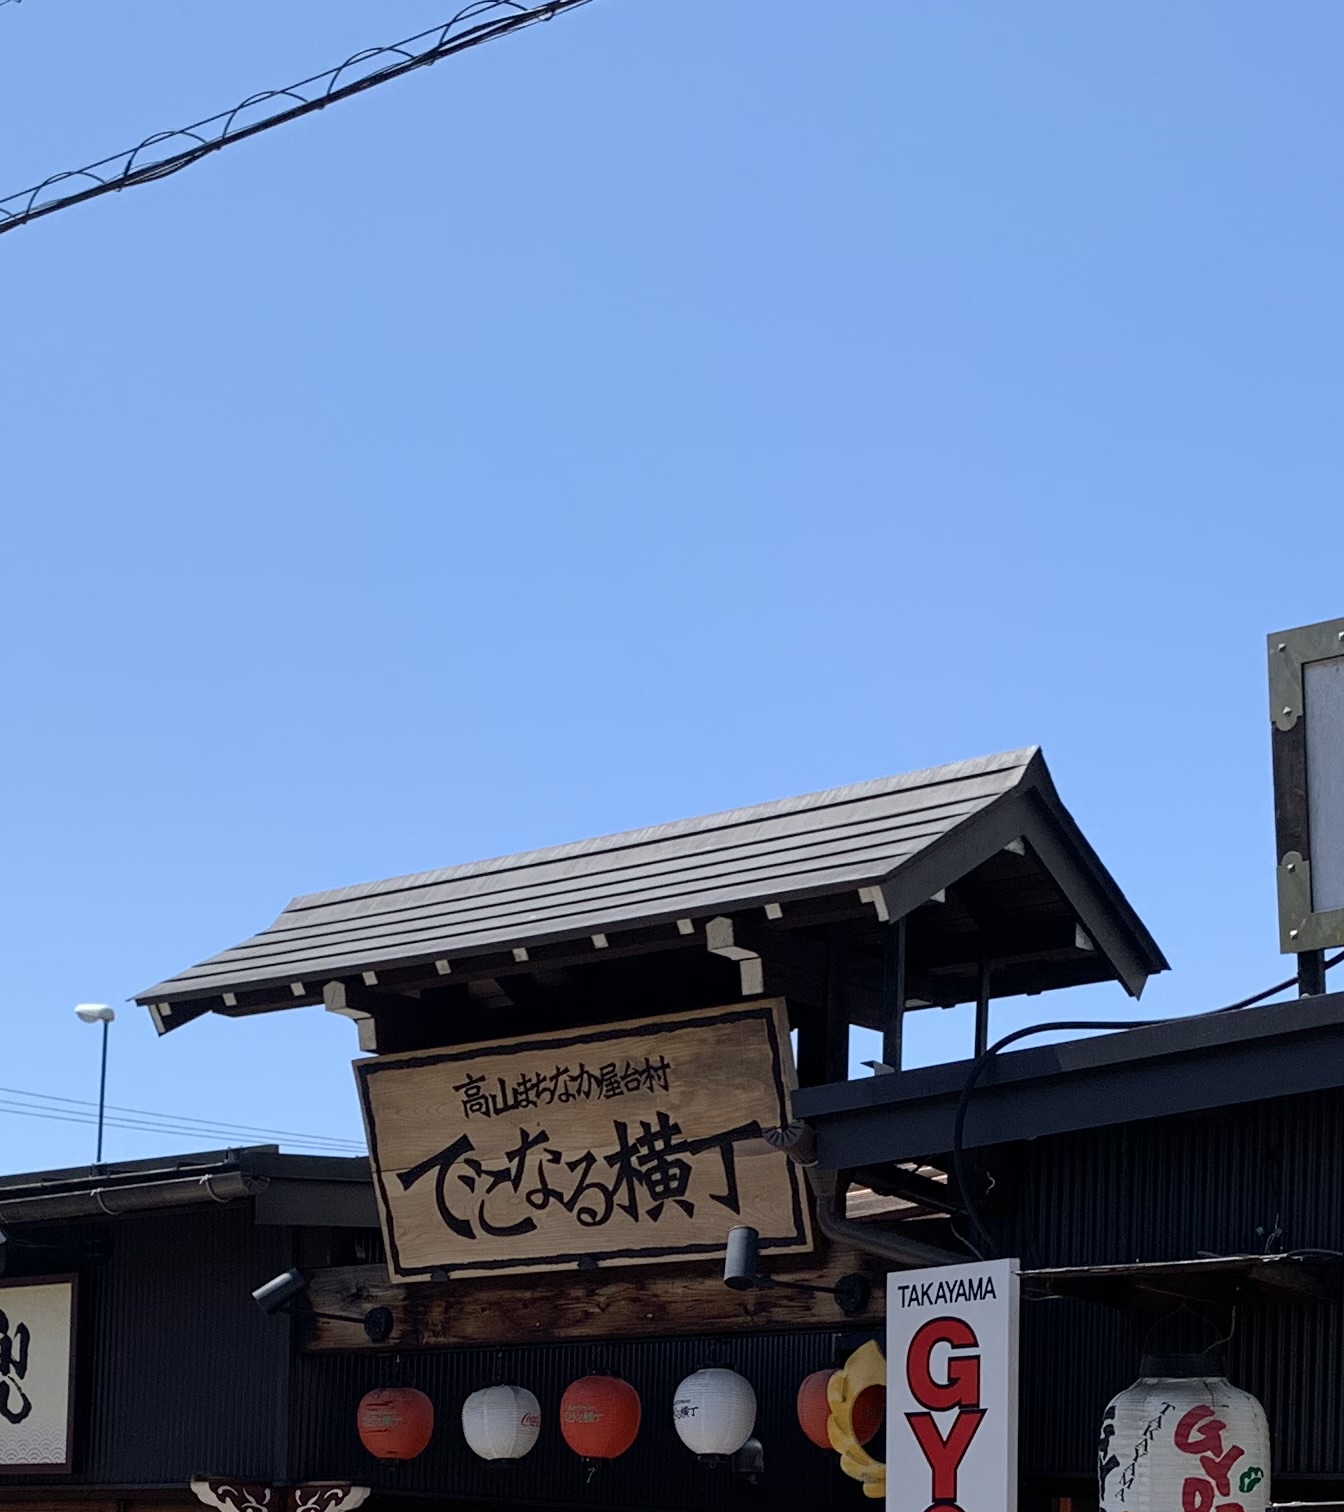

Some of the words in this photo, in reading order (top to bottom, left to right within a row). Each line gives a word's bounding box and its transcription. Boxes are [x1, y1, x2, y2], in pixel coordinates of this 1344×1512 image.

[453, 1055, 671, 1119] 高山まちなか屋台村
[397, 1110, 763, 1239] でこなる横丁
[897, 1276, 997, 1308] TAKAYAMA
[1115, 1401, 1176, 1503] TAKAYAMA
